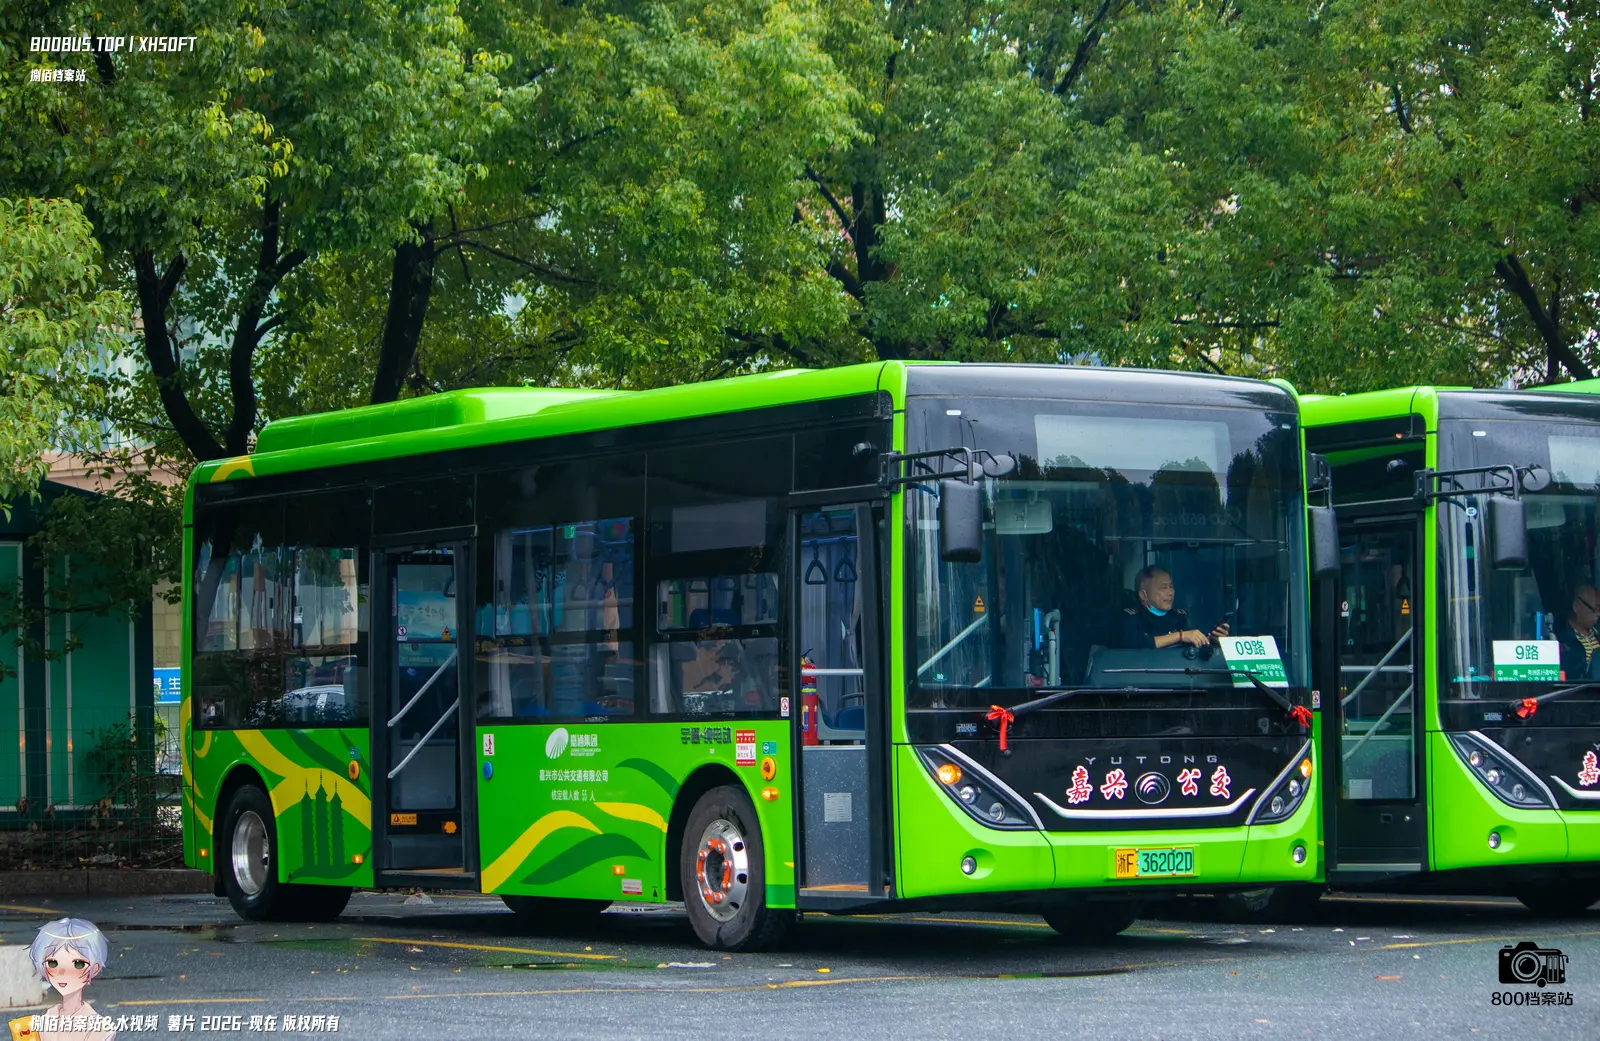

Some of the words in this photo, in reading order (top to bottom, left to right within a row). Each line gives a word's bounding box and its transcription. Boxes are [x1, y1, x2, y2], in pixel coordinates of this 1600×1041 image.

[1235, 640, 1266, 655] 09路
[1515, 645, 1539, 660] 9路
[1086, 755, 1217, 765] YUTONG
[540, 769, 608, 782] 嘉兴市公共交通有限公司
[1141, 851, 1193, 873] 36202D
